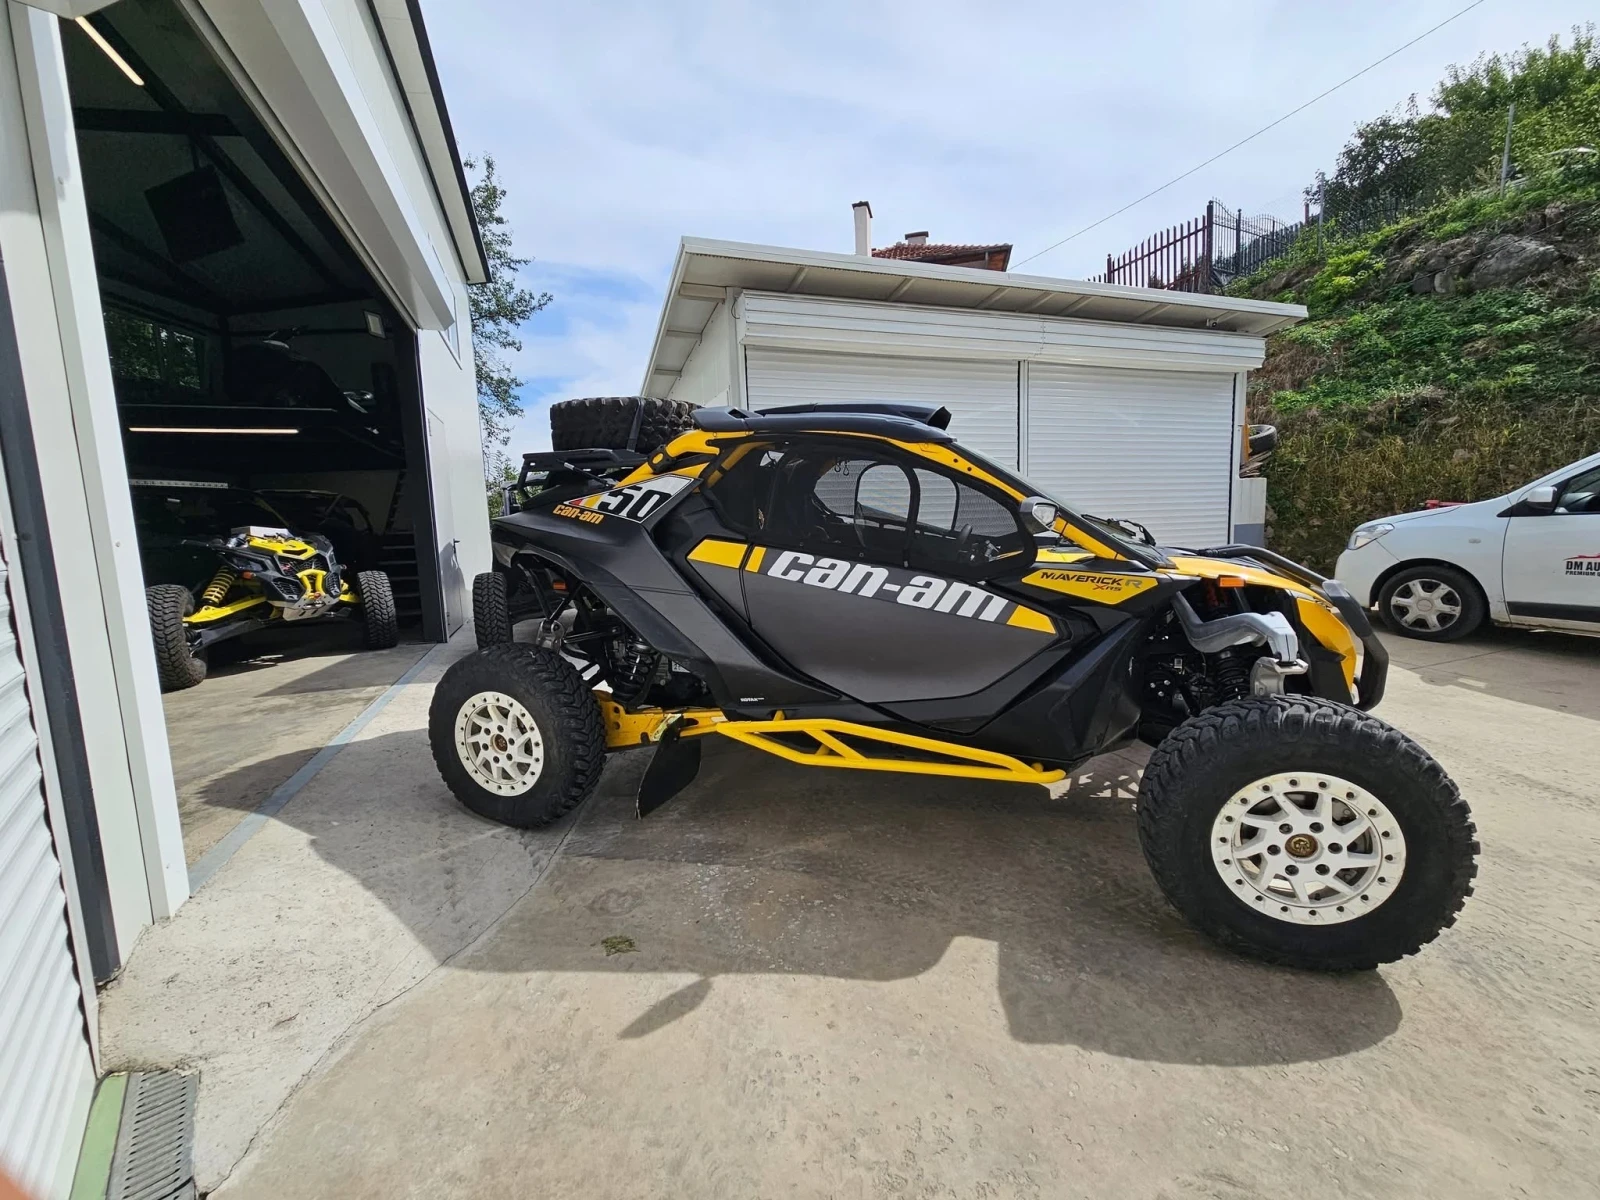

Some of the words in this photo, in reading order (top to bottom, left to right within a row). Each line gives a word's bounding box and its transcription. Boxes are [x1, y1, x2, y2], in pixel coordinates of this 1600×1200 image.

[597, 485, 673, 518] 50
[553, 504, 605, 524] can-am
[1566, 561, 1584, 570] DM
[767, 550, 1009, 622] can-am
[1041, 572, 1123, 586] MAVERICK
[1124, 579, 1143, 589] R
